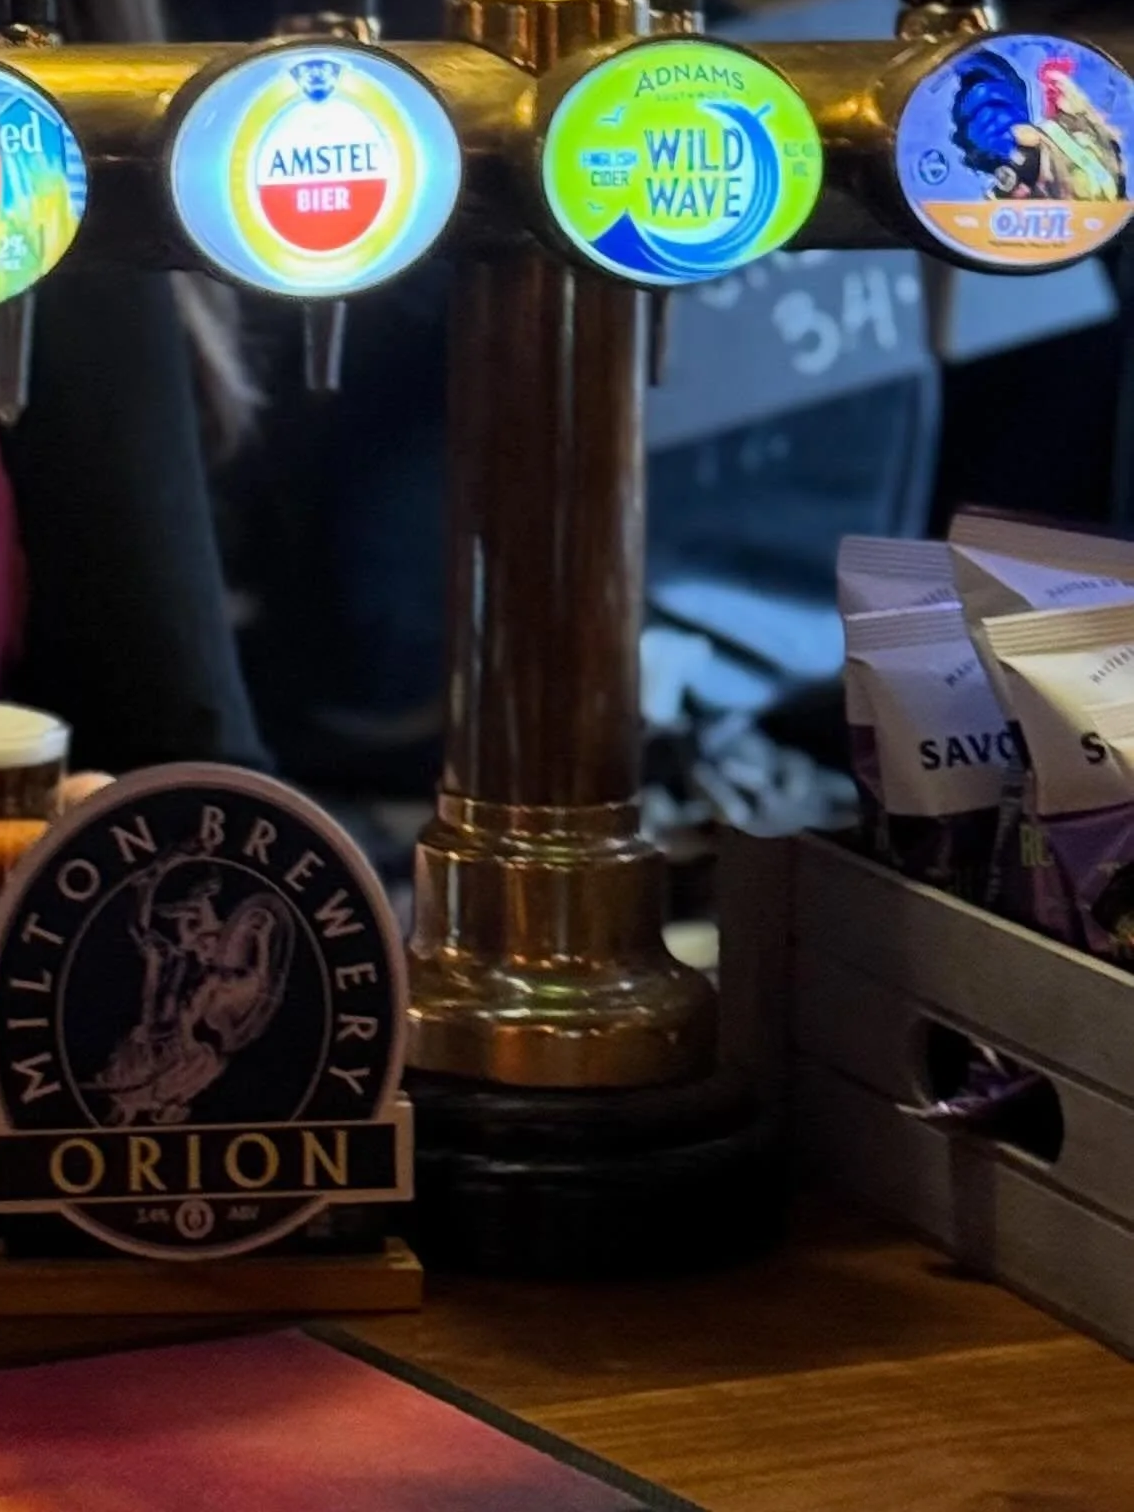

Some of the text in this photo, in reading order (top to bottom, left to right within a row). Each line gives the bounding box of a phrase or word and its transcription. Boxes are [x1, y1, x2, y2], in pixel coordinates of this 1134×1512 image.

[634, 64, 745, 98] ADNAMS
[268, 143, 379, 178] AMSTEL
[644, 128, 744, 172] WILD
[591, 170, 630, 188] CIDER
[646, 177, 742, 218] WAVE
[296, 186, 351, 213] BIER
[8, 806, 379, 1105] MILTON BREWERY
[50, 1129, 350, 1194] ORION
